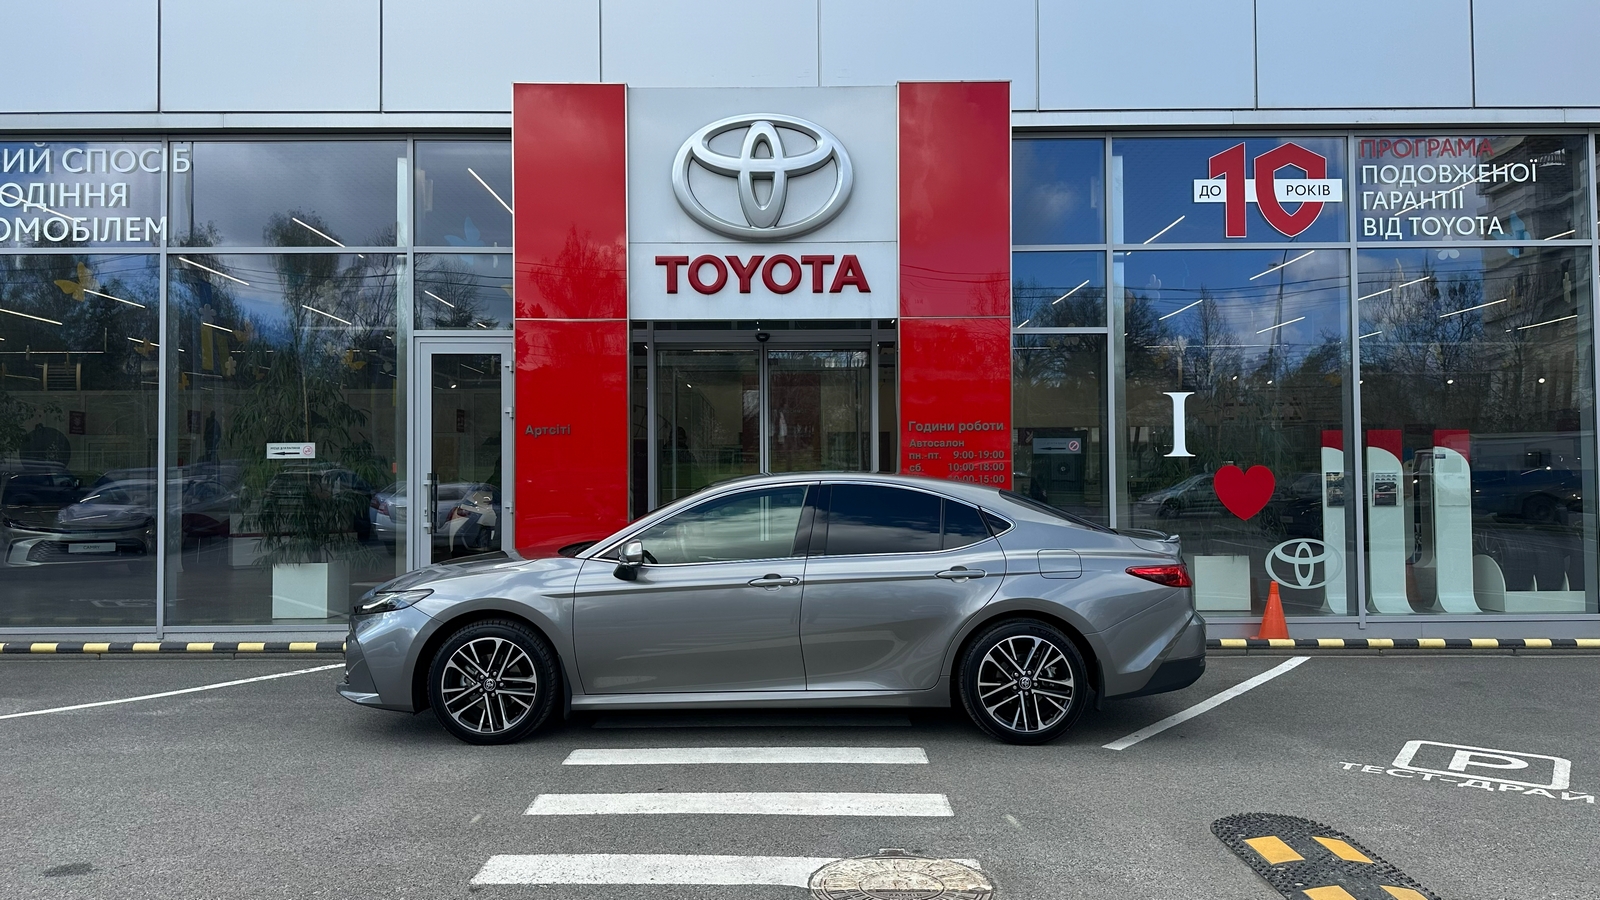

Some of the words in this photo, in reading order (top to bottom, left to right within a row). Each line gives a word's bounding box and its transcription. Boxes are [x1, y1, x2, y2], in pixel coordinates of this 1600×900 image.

[3, 142, 50, 173] ИЙ
[62, 148, 191, 173] СПОСІБ
[1360, 138, 1495, 158] ПРОГРАМА
[1362, 159, 1538, 187] ПОДОВЖЕНОЇ
[0, 182, 127, 212] ОДІННЯ
[1199, 185, 1222, 198] ДО
[1209, 142, 1327, 238] 10
[1286, 184, 1331, 196] РОКІВ
[1363, 186, 1465, 210] ГАРАНТІЇ
[1364, 217, 1402, 240] ВІД
[1408, 216, 1505, 236] TOYOTA
[655, 254, 871, 295] TOYOTA
[525, 423, 571, 438] Артсіті
[908, 421, 955, 433] Години
[958, 420, 1004, 433] роботи
[1163, 391, 1196, 457] I
[909, 439, 965, 447] Автосалон
[909, 452, 942, 460] пн.-пт.
[953, 451, 1005, 459] 9:00-19:00
[909, 463, 924, 472] сб.
[948, 463, 1005, 471] 10:00-18:00
[1448, 749, 1529, 771] P
